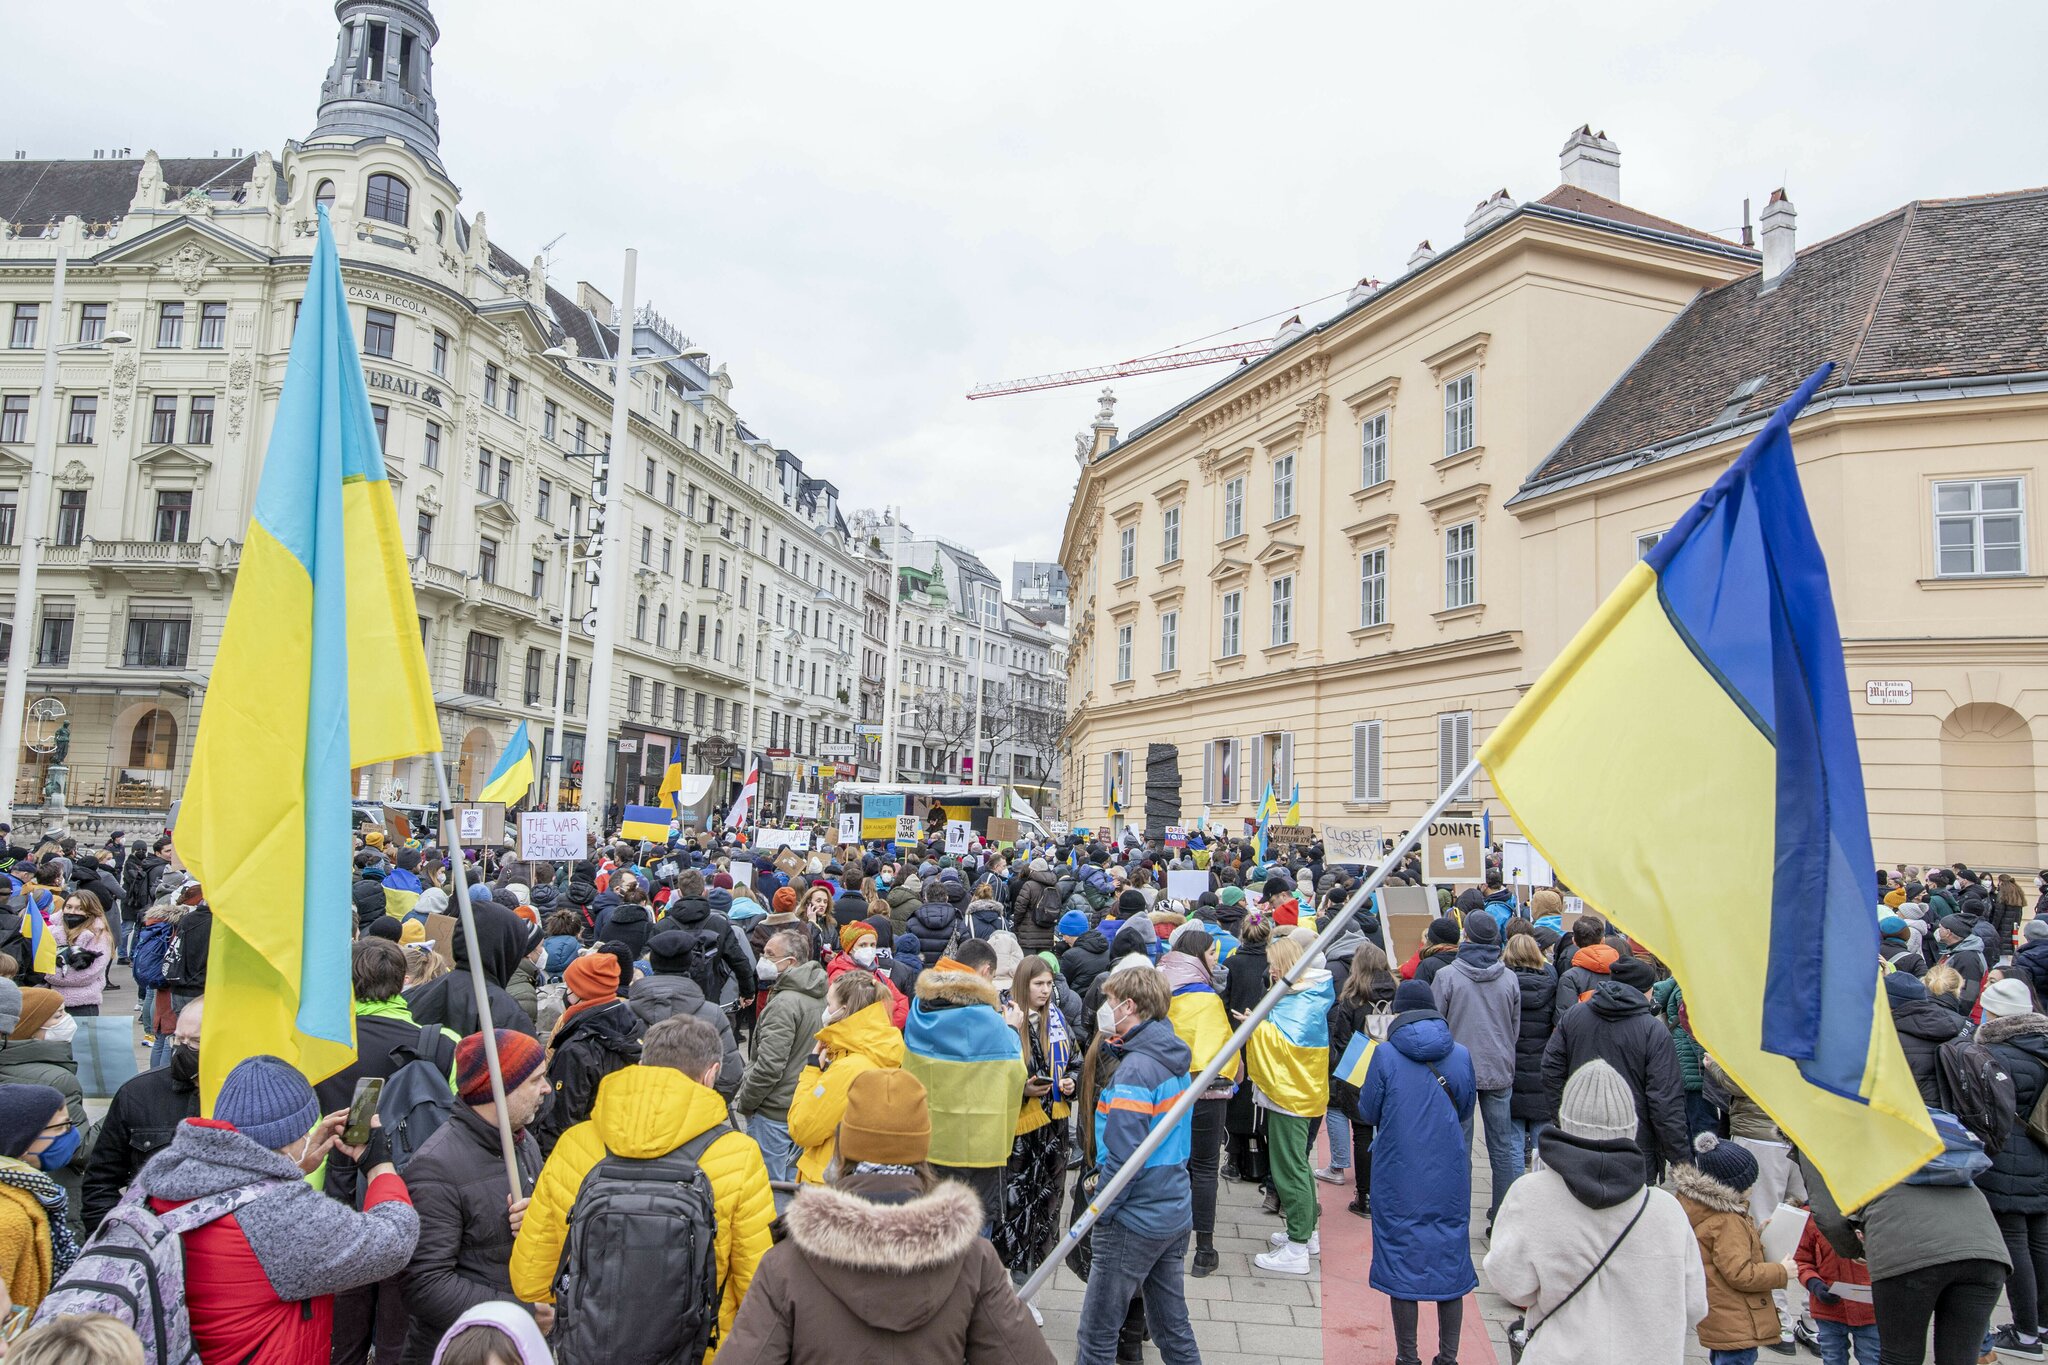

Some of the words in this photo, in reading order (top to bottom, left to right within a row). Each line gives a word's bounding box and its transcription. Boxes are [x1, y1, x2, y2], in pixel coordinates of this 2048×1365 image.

[349, 286, 380, 301] CASA
[385, 293, 428, 316] PICCOLA
[868, 797, 903, 807] HELFT
[526, 818, 548, 832] THE
[553, 818, 580, 832] WAR
[899, 817, 916, 825] STOP
[788, 831, 809, 842] WAR
[1326, 826, 1375, 843] CLOSE
[1428, 822, 1481, 838] DONATE
[528, 833, 537, 845] IS
[542, 834, 567, 846] HERE
[526, 846, 545, 857] ACT
[550, 847, 578, 858] NOW
